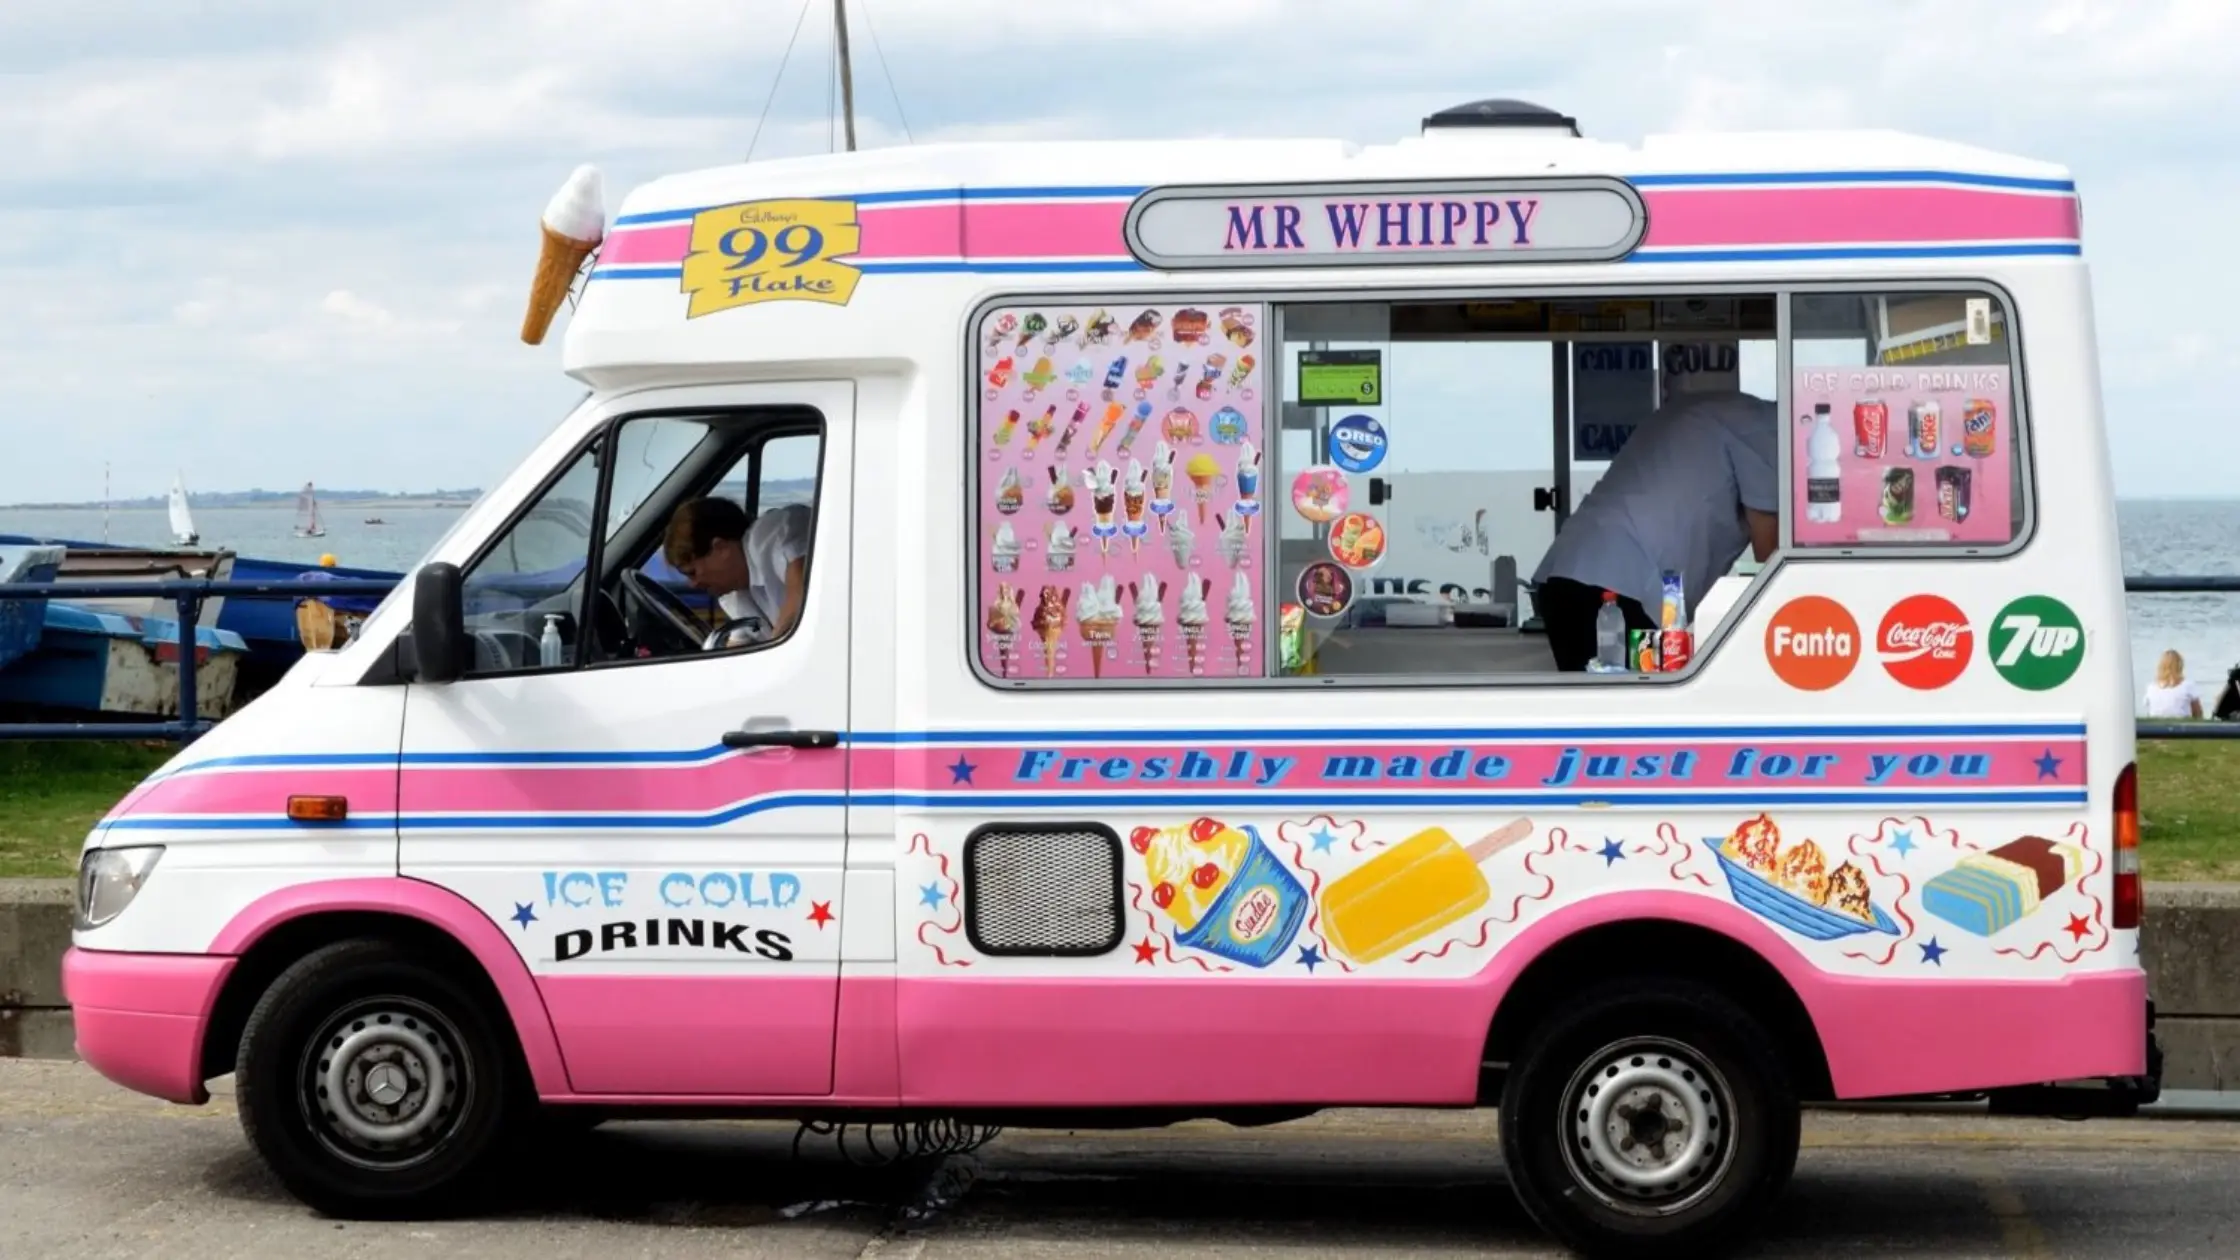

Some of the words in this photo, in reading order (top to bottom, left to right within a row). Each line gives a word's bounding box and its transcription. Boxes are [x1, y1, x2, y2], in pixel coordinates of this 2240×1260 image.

[1223, 204, 1305, 250] MR
[1325, 200, 1539, 249] WHIPPY
[718, 224, 824, 271] 99
[719, 270, 836, 298] Flake
[1802, 372, 1838, 392] ICE
[1848, 372, 1905, 392] COLD
[1918, 373, 2000, 391] DRINKS
[1335, 428, 1384, 446] OREO
[1773, 626, 1851, 658] Fanta
[1995, 615, 2079, 666] 7UP
[1013, 748, 1295, 786] Freshly
[1320, 748, 1511, 782] made
[1542, 746, 1700, 787] just
[1726, 747, 1838, 781] for
[1865, 749, 1994, 785] you
[541, 871, 628, 909] ICE
[658, 871, 802, 909] COLD
[1234, 892, 1272, 940] Sundae
[554, 917, 794, 963] DRINKS
